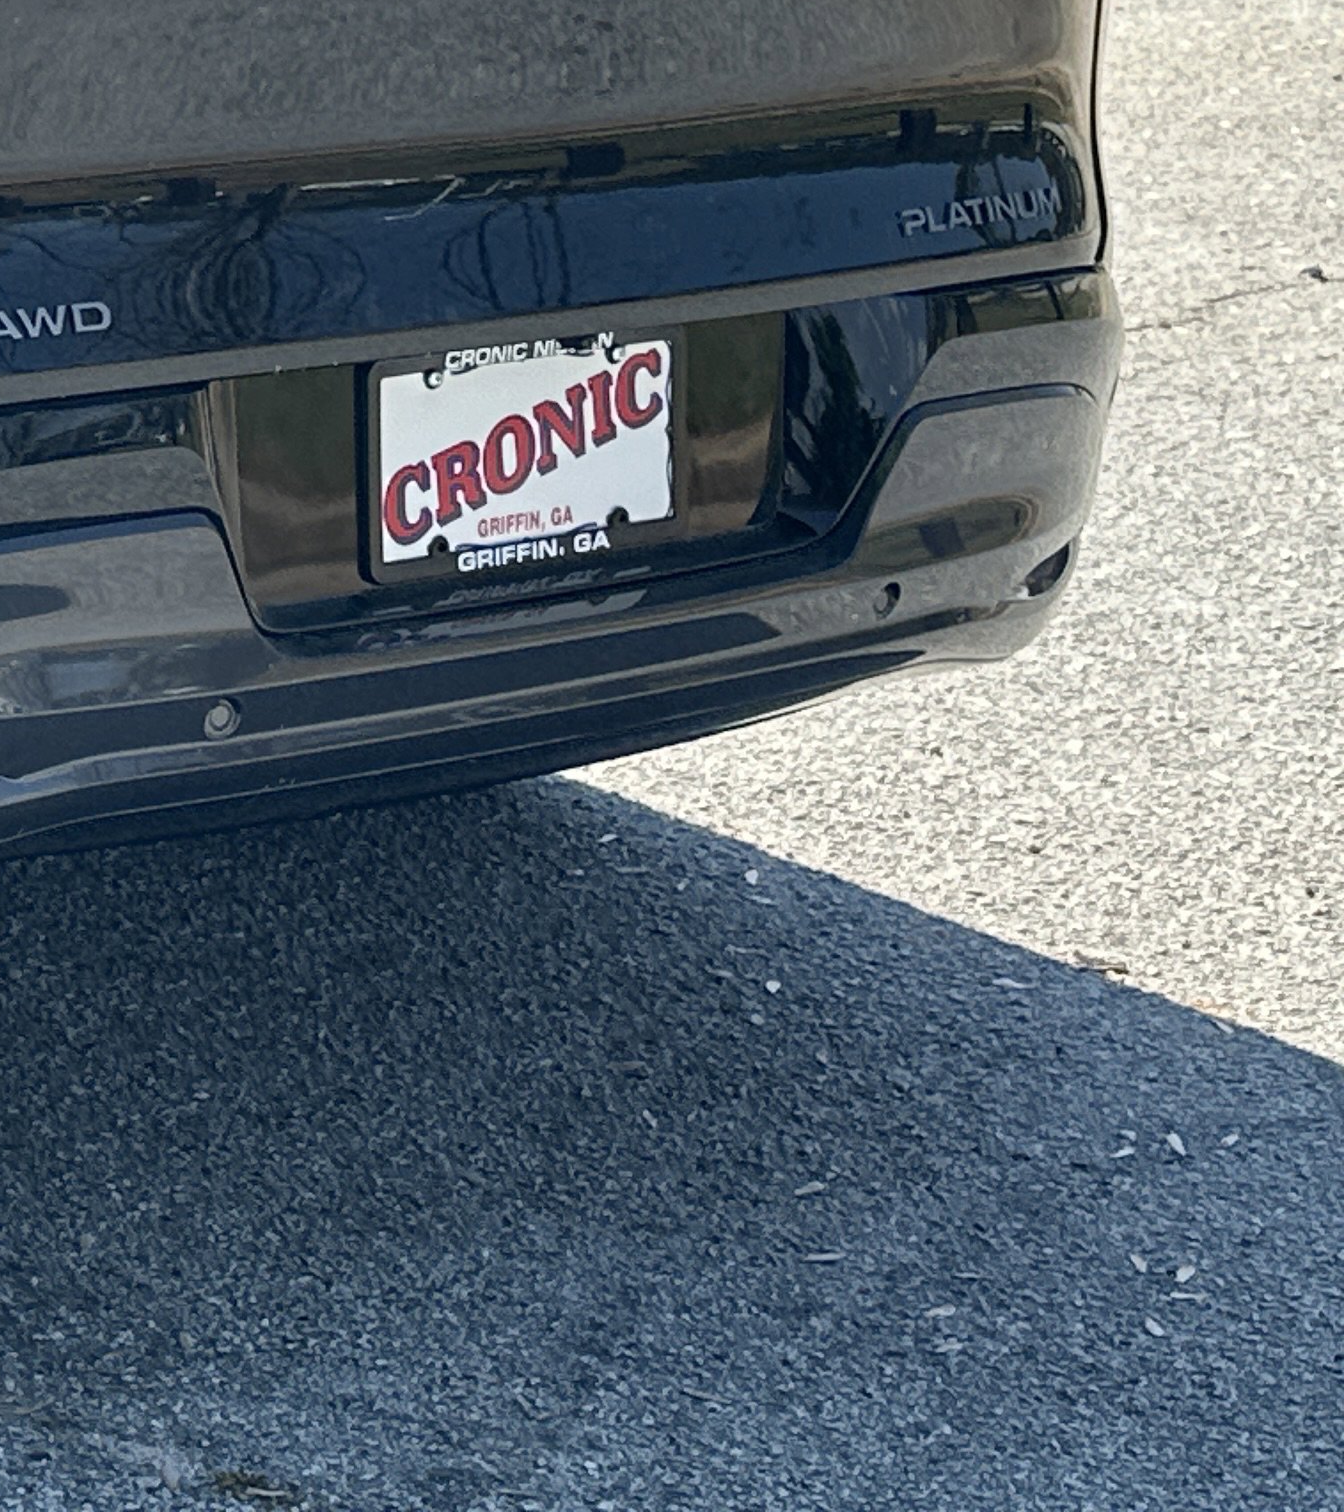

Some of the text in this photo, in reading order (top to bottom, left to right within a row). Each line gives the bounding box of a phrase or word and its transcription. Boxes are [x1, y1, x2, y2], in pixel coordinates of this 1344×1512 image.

[899, 175, 1062, 237] PLATINUM
[444, 331, 614, 372] CRONIC NIN
[383, 348, 664, 546] CRONIC
[476, 505, 574, 539] GRIFFIN, GA
[572, 531, 611, 554] GA
